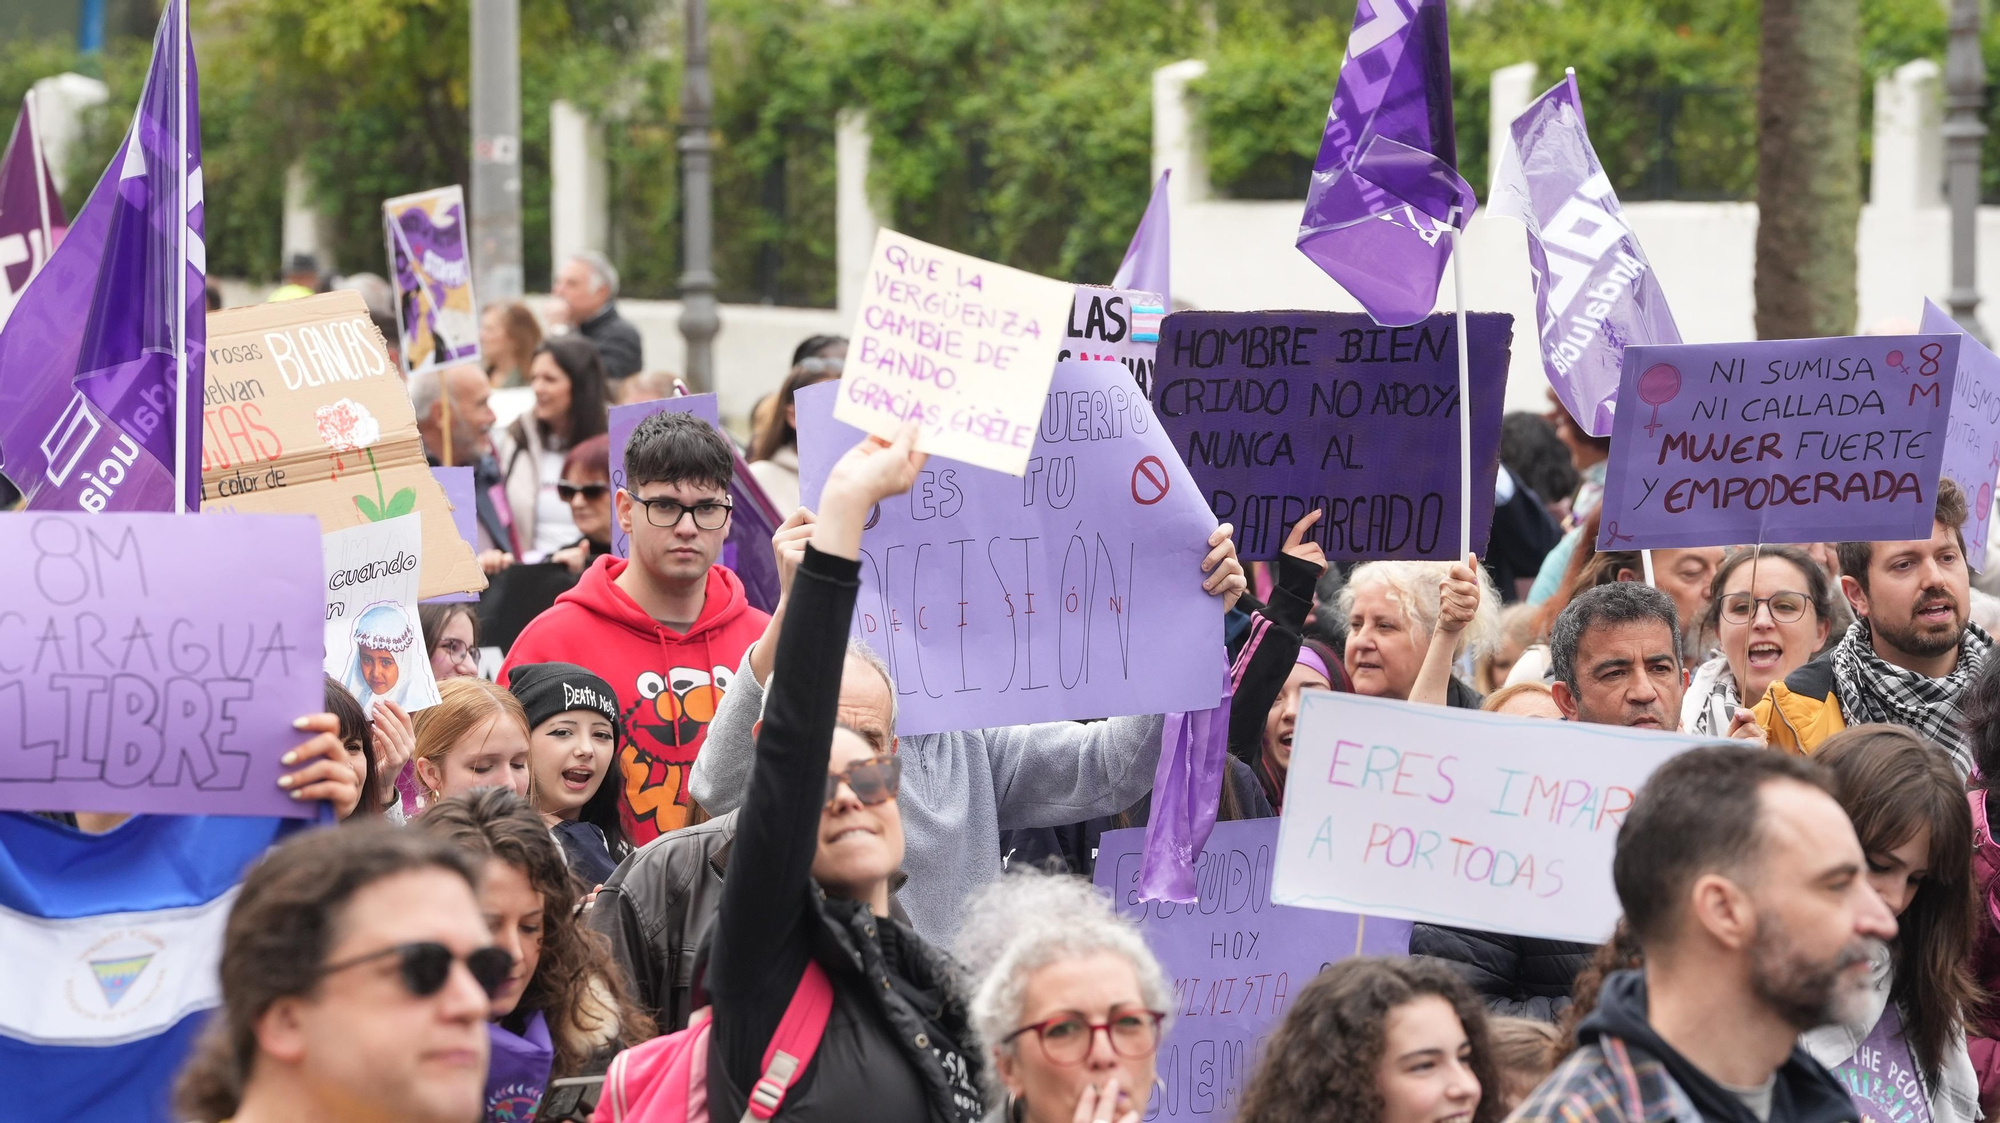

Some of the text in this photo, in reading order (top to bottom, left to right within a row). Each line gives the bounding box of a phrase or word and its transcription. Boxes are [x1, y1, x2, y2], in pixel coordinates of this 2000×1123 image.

[886, 245, 983, 292] QUE LA
[875, 270, 1041, 340] VERGÜENZA
[1067, 295, 1127, 343] LAS
[210, 318, 386, 391] rosas BLANCAS
[974, 341, 1019, 371] DE
[1173, 324, 1451, 369] HOMBRE BIEN
[1918, 342, 1943, 377] 8
[1709, 356, 1876, 385] NI SUMISA
[1039, 384, 1150, 445] UERPO
[1160, 377, 1289, 418] CRIADO
[1309, 378, 1363, 419] NO
[1691, 389, 1886, 423] NI CALLADA
[1908, 381, 1941, 408] M
[1954, 365, 2000, 425] INISMO
[1187, 431, 1364, 471] NUNCA AL
[1657, 429, 1932, 466] MUJER FUERTE
[1945, 415, 1981, 455] ONTRA
[218, 469, 259, 498] color
[265, 465, 287, 489] de
[910, 468, 963, 521] ES
[1663, 469, 1923, 514] EMPODERADA
[30, 515, 150, 607] 8M
[328, 550, 417, 591] cuando
[0, 610, 298, 680] CARAGUA
[1327, 739, 1636, 832] ERES IMPAR
[1307, 815, 1334, 861] A
[1210, 930, 1261, 960] HOY,
[1171, 971, 1289, 1017] MINISTA
